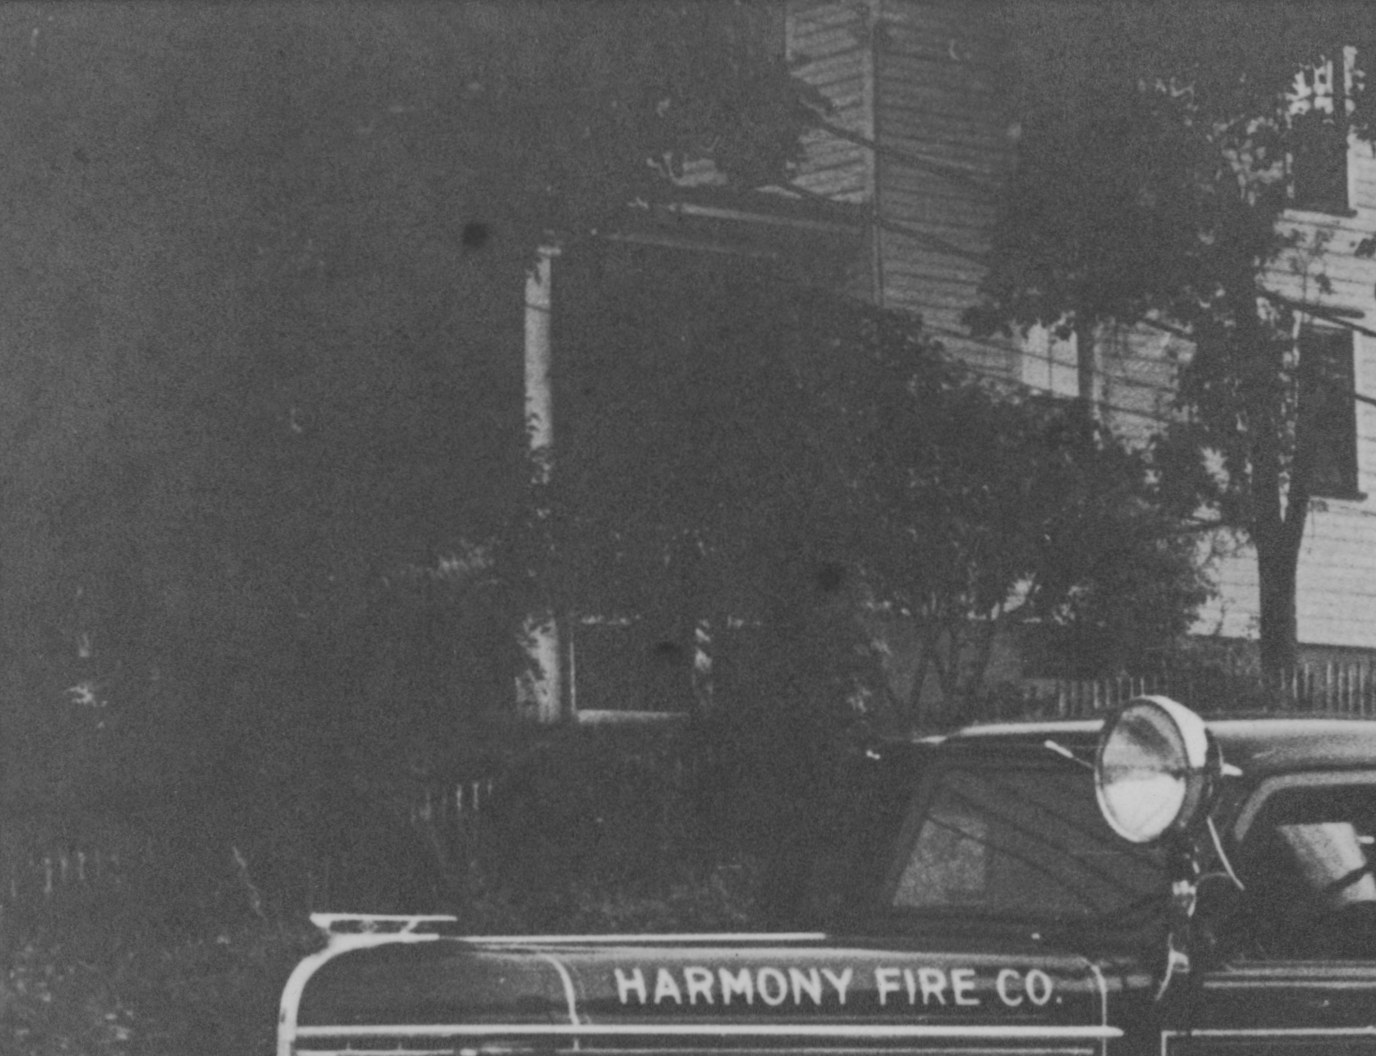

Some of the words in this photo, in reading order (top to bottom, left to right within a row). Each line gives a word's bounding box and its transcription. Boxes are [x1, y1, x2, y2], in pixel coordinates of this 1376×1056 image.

[613, 966, 854, 1006] HARMONY
[874, 966, 979, 1006] FIRE
[995, 968, 1063, 1006] CO.
